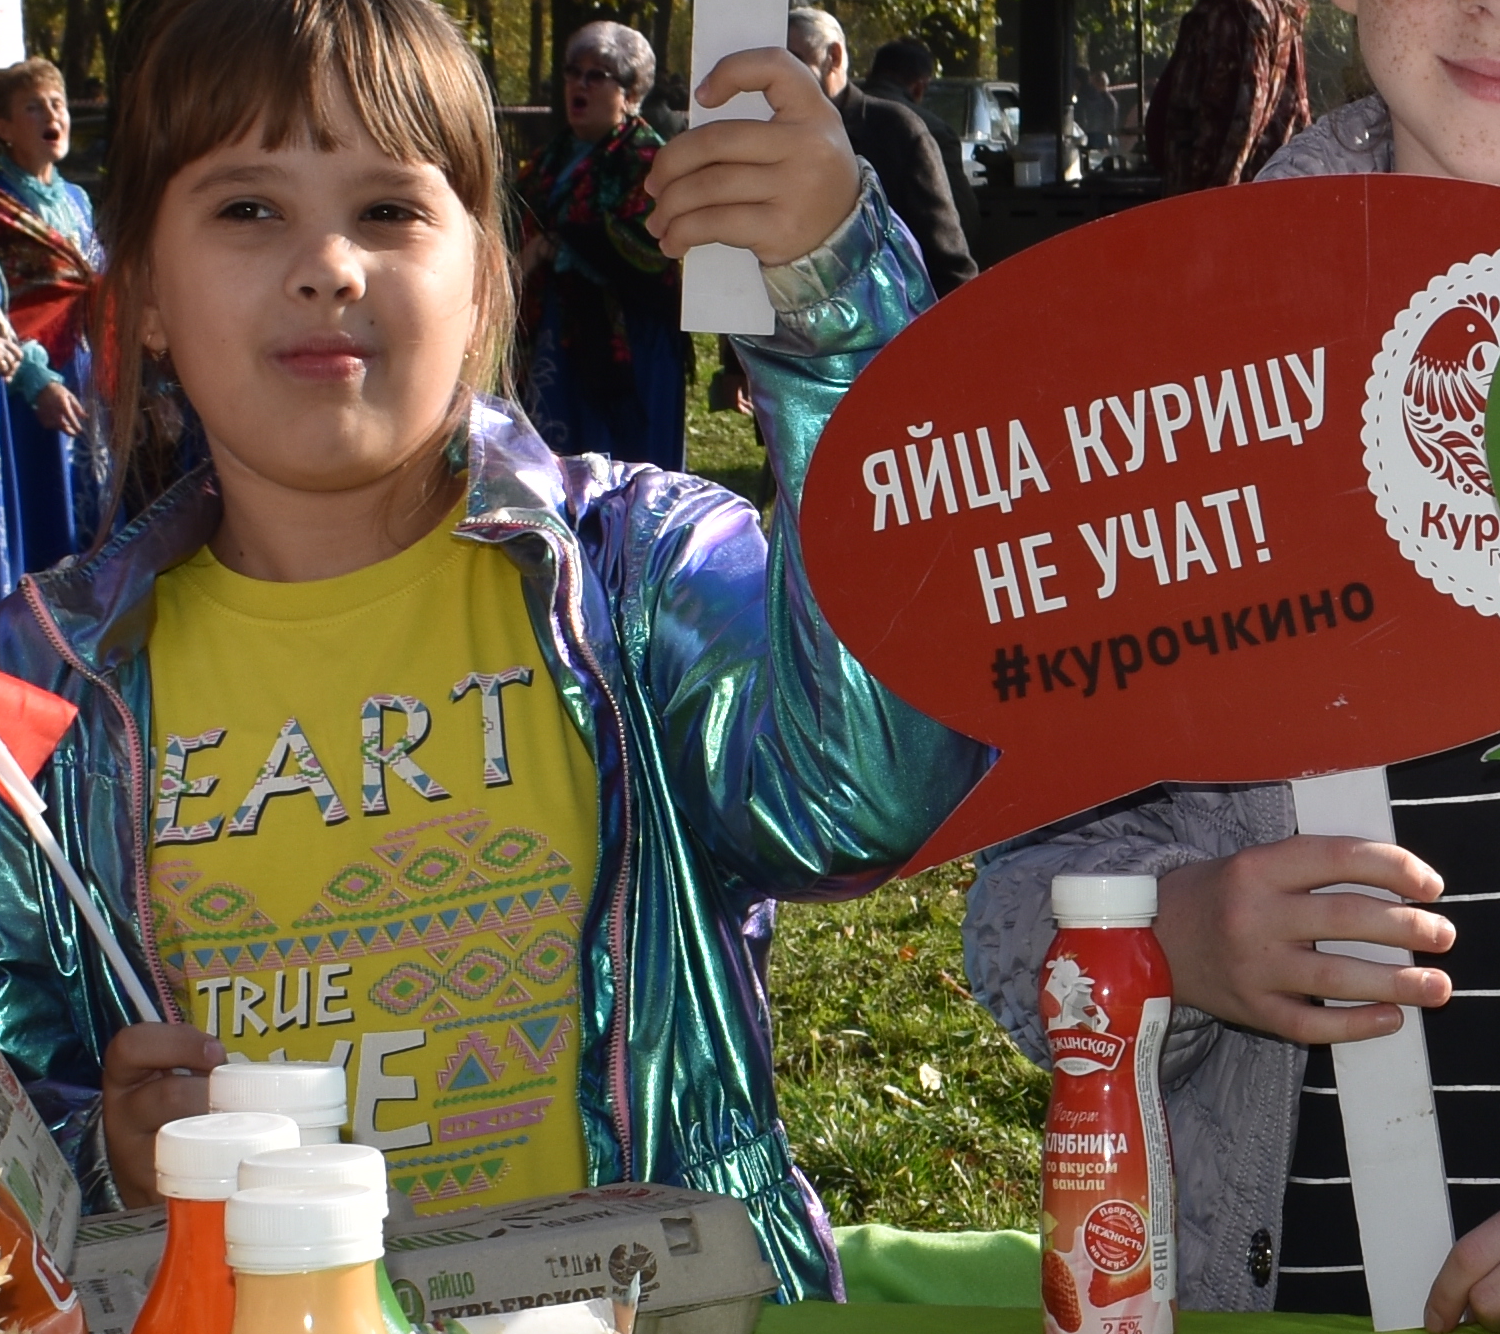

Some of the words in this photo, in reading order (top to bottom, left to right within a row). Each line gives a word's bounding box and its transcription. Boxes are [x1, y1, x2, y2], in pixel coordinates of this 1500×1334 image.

[861, 419, 1051, 532] ЯЙЦА
[1063, 347, 1328, 485] КУРИЦУ
[974, 532, 1069, 625] НЕ
[1078, 484, 1274, 601] УЧАТ!
[990, 581, 1377, 705] #курочкино
[150, 667, 536, 847] EART
[196, 963, 357, 1038] TRUE
[1046, 1161, 1057, 1173] со
[1059, 1161, 1118, 1177] вкусом
[1052, 1179, 1106, 1191] ванили
[1087, 1222, 1143, 1252] НЕЖНОСТЬ
[1099, 1206, 1144, 1235] Попробуй
[427, 1269, 477, 1301] ЯЙЦО
